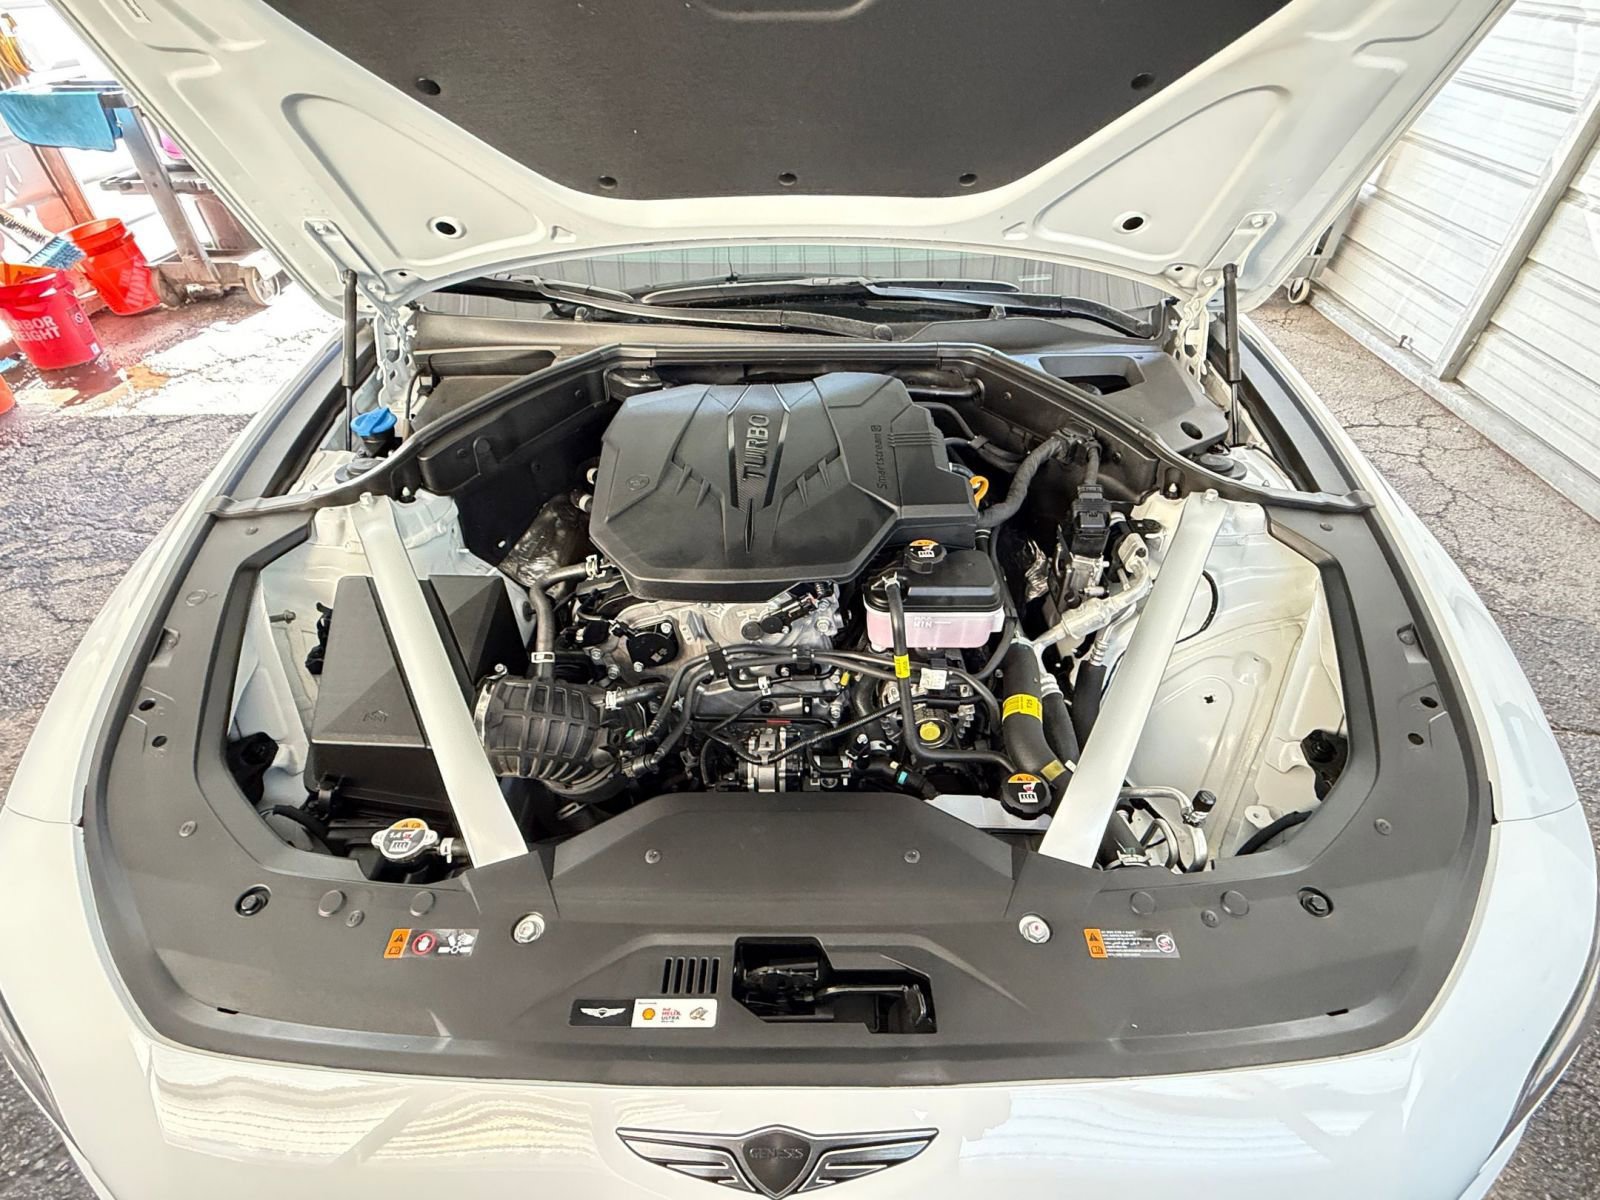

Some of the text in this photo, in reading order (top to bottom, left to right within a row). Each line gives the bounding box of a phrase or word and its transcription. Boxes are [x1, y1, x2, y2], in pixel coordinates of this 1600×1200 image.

[742, 414, 770, 481] TURBO
[874, 433, 888, 489] Smartstream
[749, 1147, 804, 1159] GENESIS
